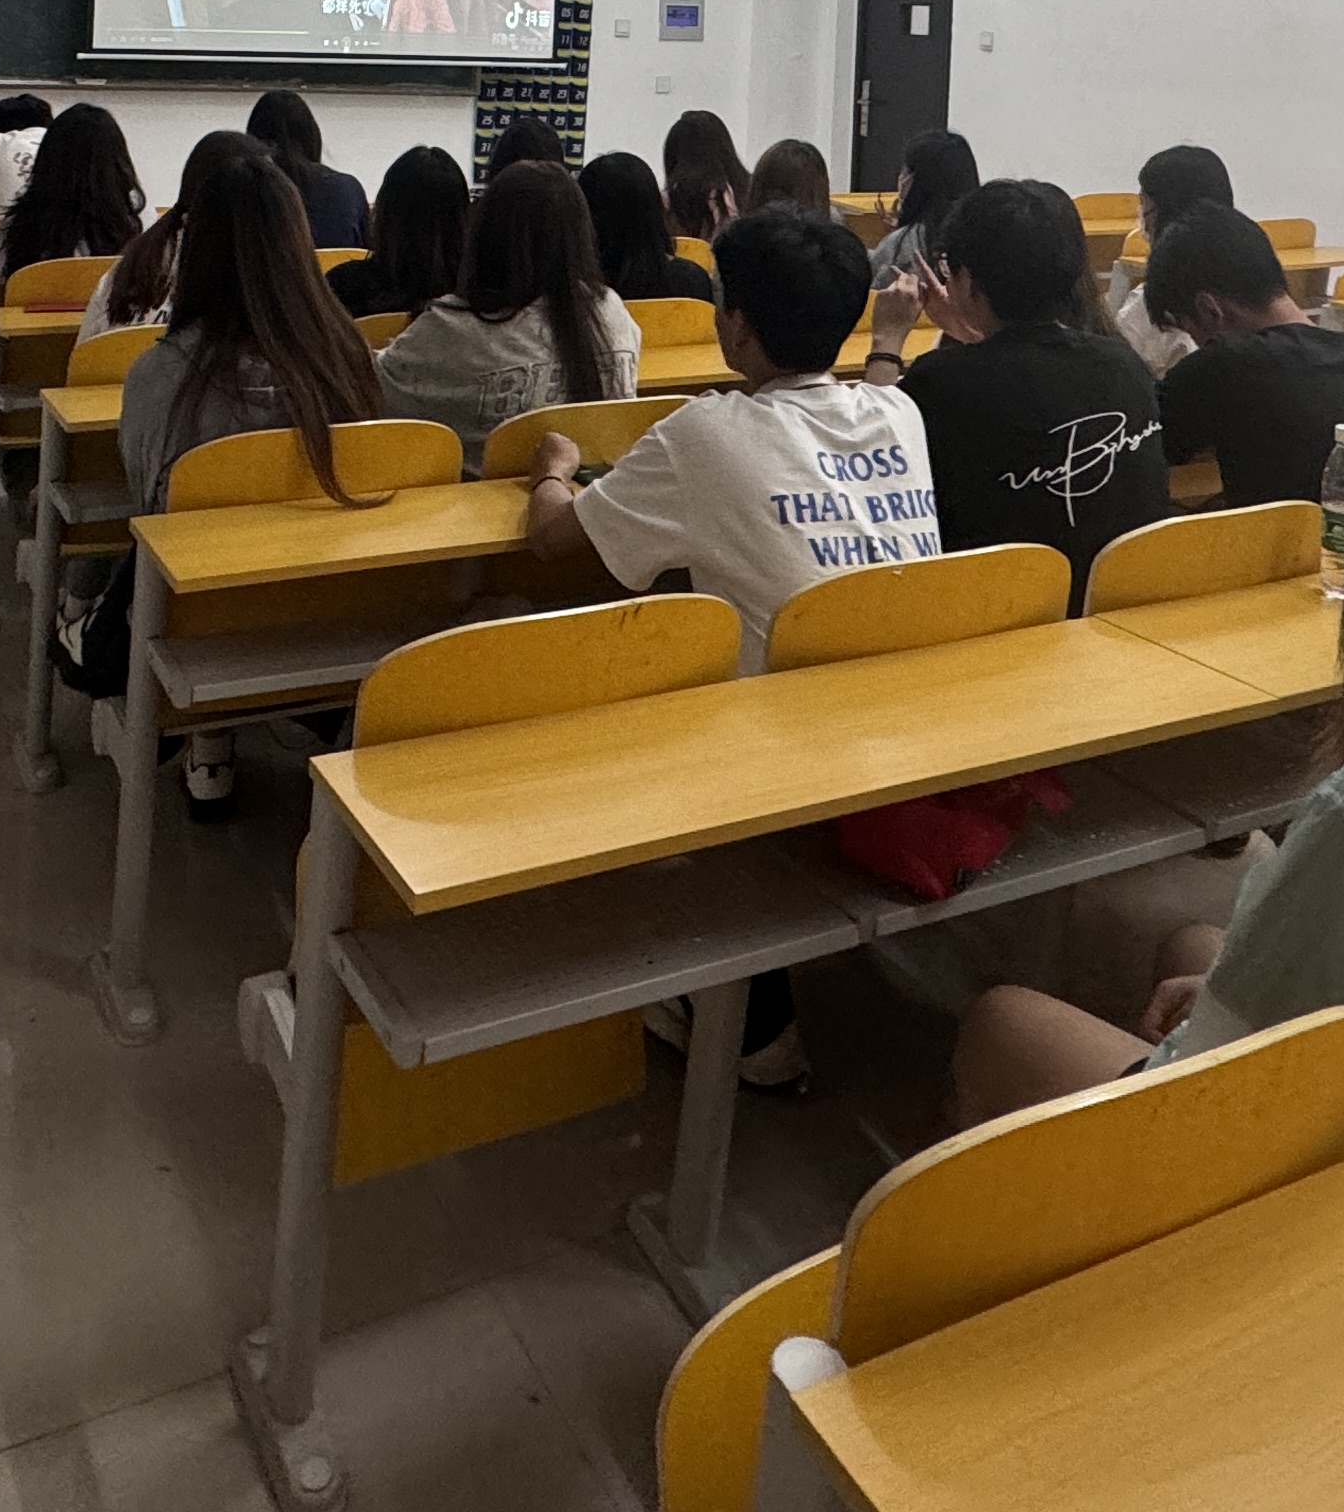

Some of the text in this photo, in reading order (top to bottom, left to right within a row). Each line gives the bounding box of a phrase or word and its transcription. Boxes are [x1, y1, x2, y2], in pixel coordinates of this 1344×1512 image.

[525, 9, 551, 27] 抖音
[521, 88, 532, 98] 21
[480, 143, 492, 153] 31
[816, 444, 909, 482] CROSS
[769, 491, 856, 525] THAT
[806, 534, 903, 567] WHEN
